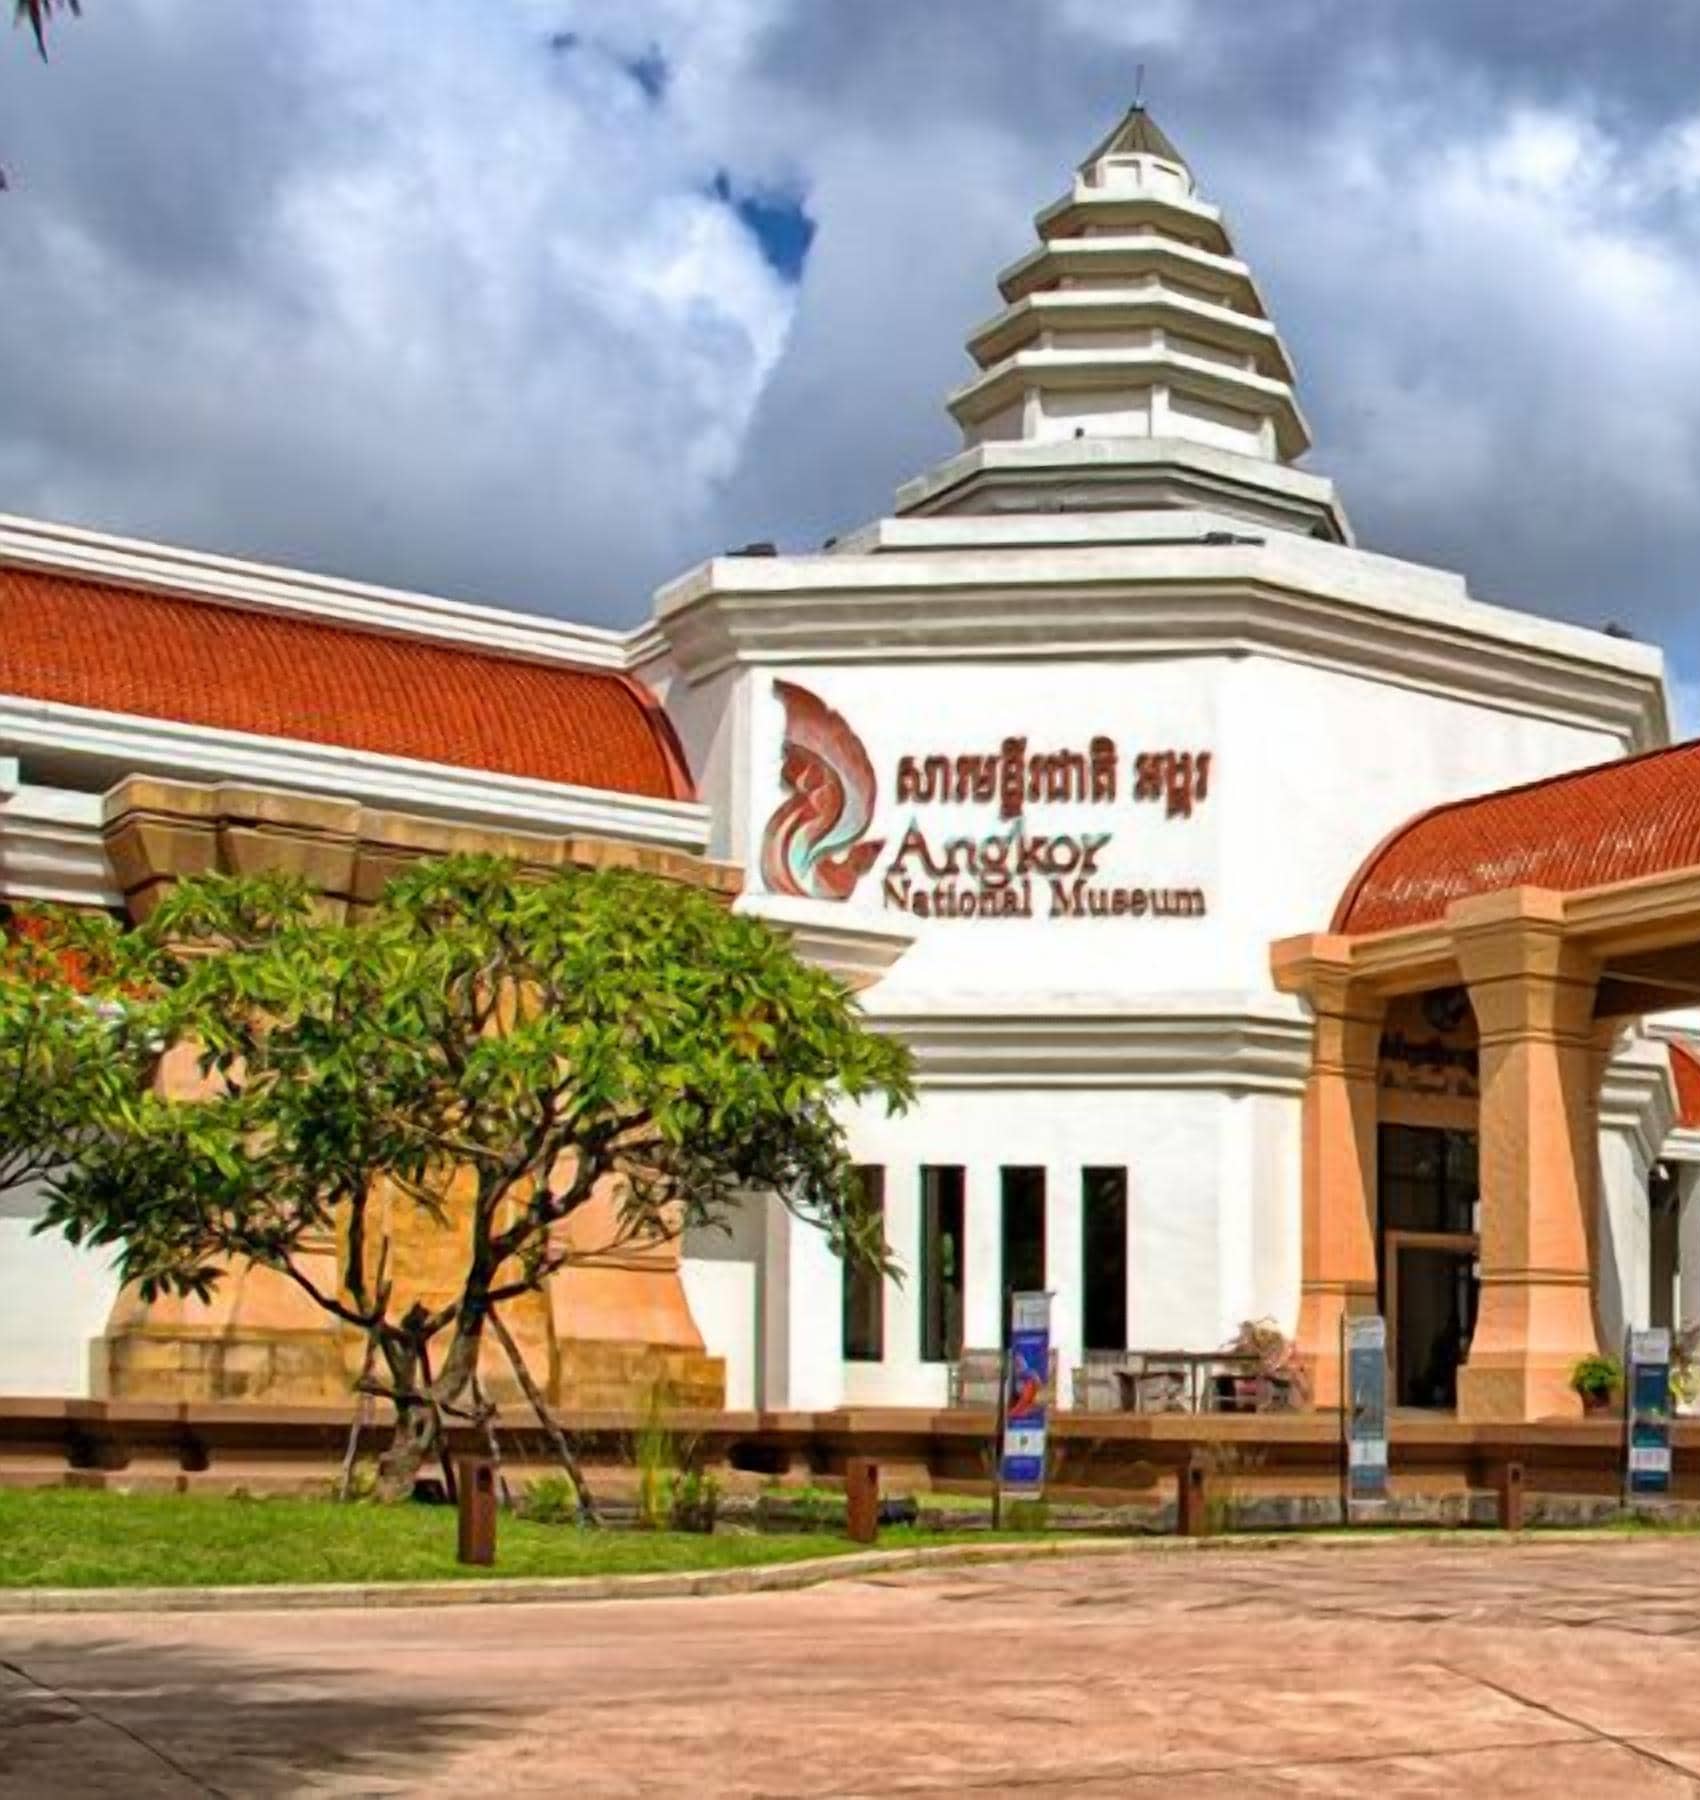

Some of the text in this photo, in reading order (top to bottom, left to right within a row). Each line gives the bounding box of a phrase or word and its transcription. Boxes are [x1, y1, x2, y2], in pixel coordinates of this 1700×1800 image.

[893, 818, 1112, 888] Angkor
[882, 870, 1207, 917] National Museum
